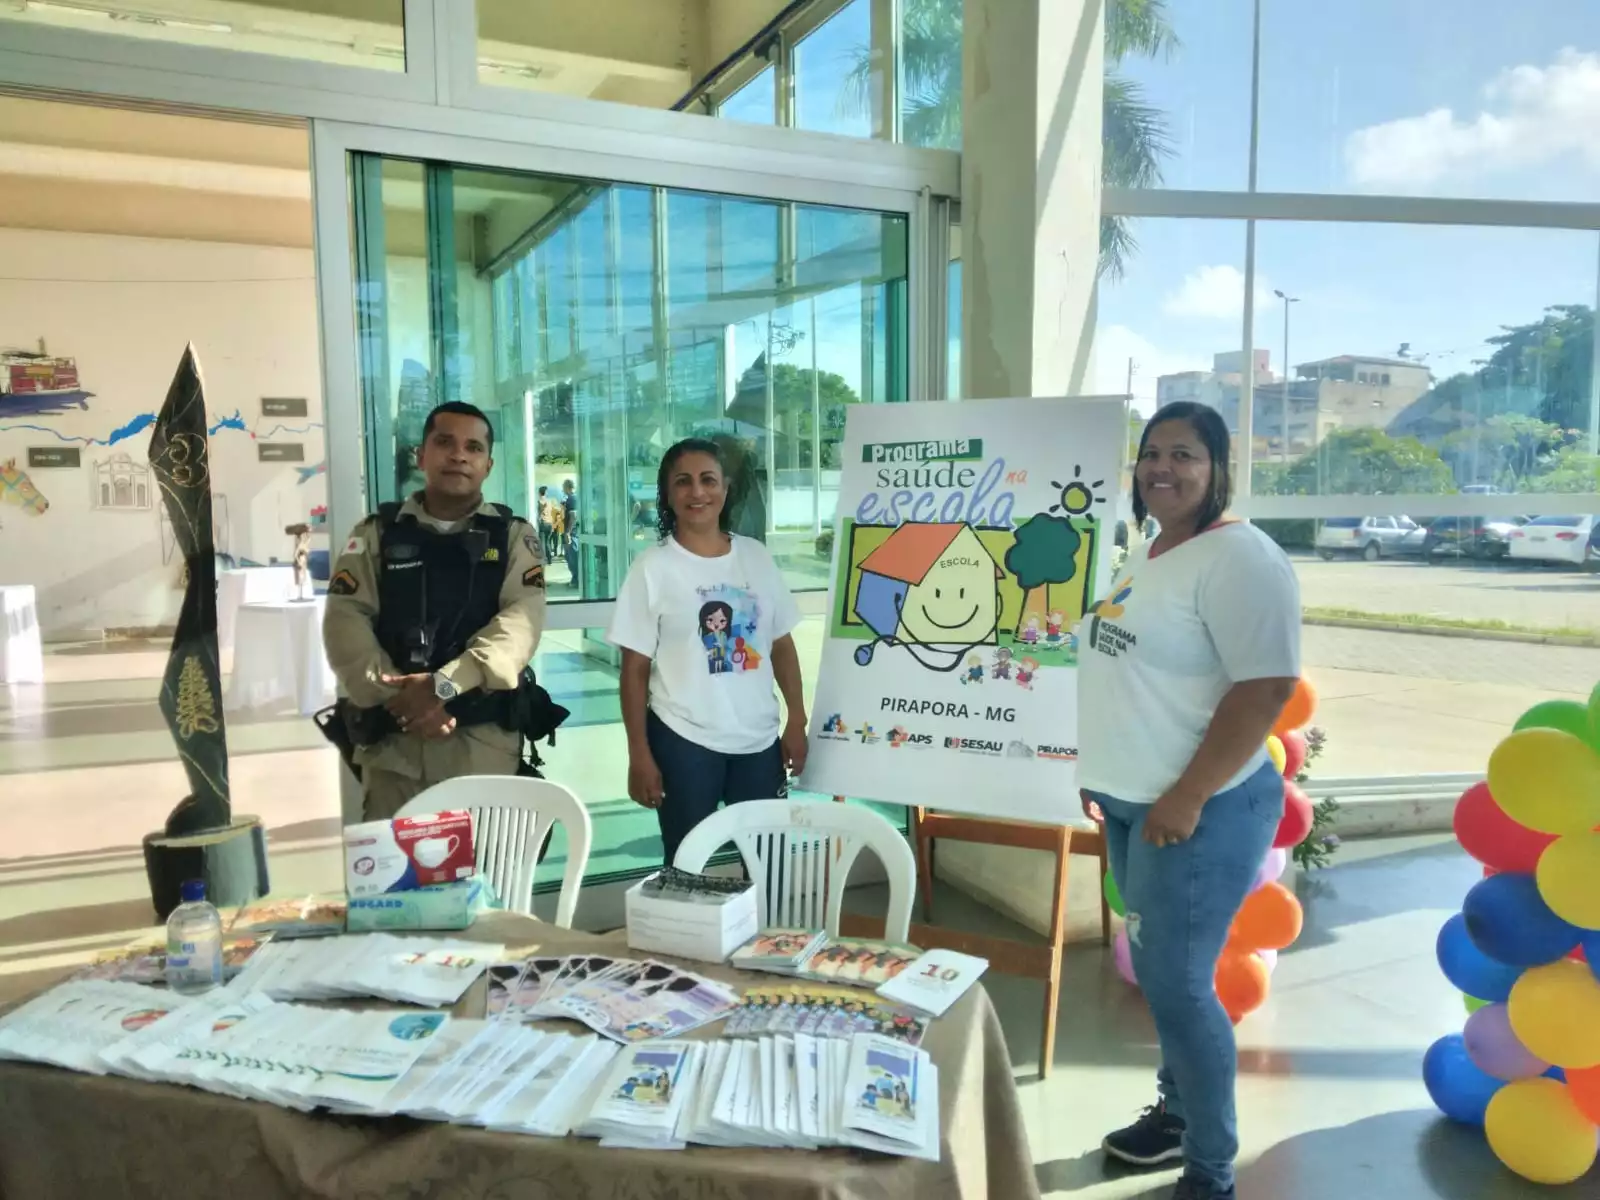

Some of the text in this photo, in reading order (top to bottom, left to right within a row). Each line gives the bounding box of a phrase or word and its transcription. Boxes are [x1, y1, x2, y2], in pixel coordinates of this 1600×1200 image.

[871, 438, 970, 464] Programa
[876, 460, 1028, 488] saúde na
[856, 457, 1016, 531] escola
[940, 557, 980, 569] ESCOLA
[880, 697, 968, 719] PIRAPORA
[985, 705, 1016, 722] MG
[907, 733, 932, 745] APS
[960, 738, 1003, 752] SESAU
[1037, 744, 1078, 756] PIRAPOR
[920, 963, 959, 981] 10
